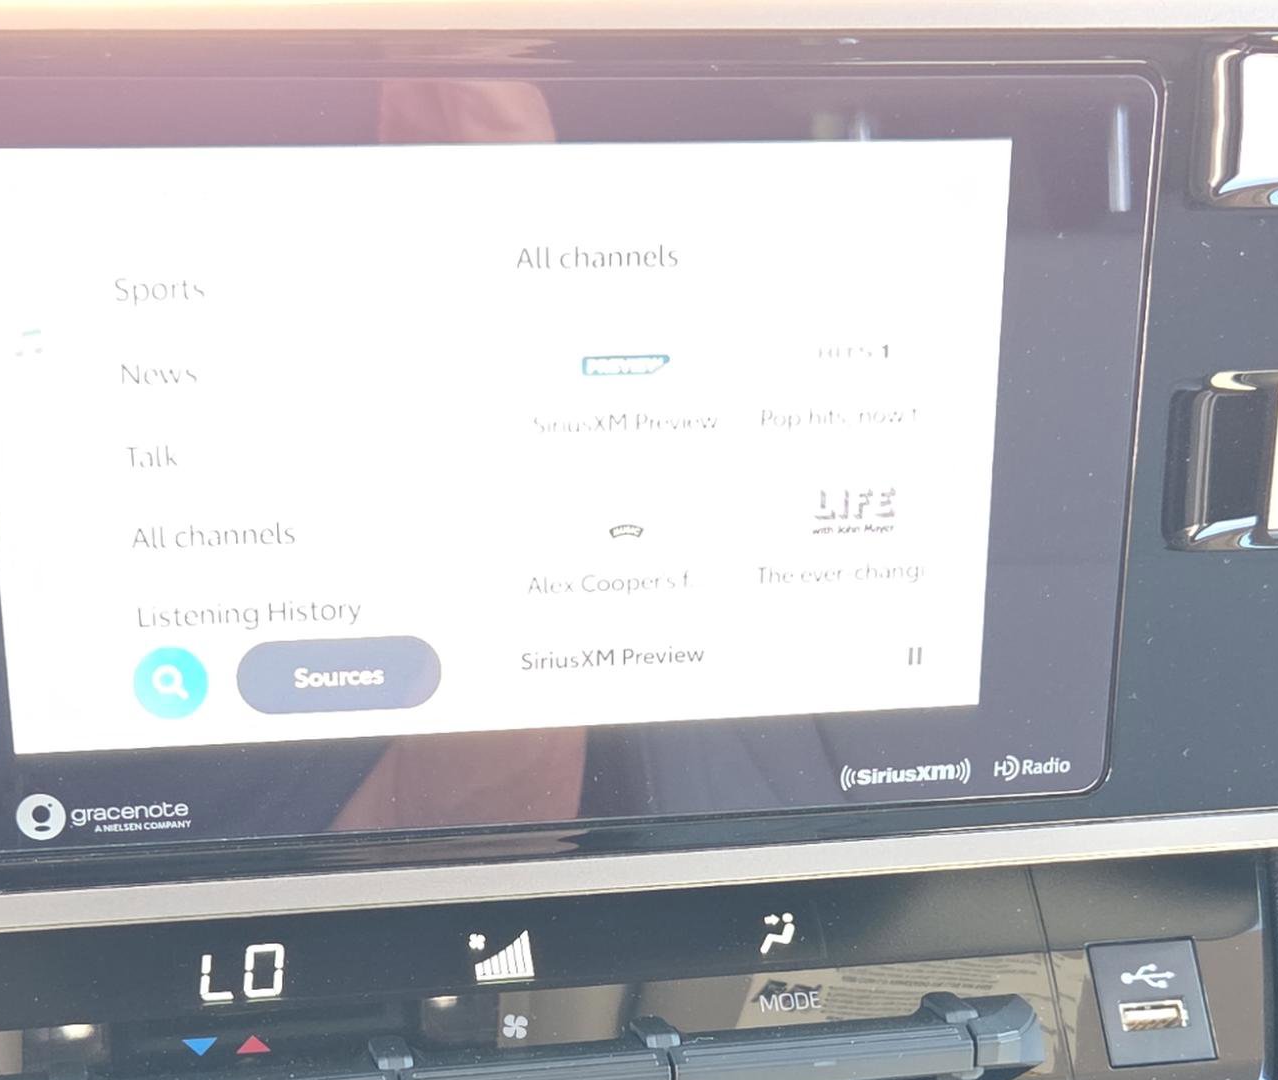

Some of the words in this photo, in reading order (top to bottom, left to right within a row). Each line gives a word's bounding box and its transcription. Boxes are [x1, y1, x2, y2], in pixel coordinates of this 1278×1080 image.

[517, 247, 551, 269] All
[560, 244, 679, 268] channels
[115, 278, 206, 306] Sports
[120, 364, 198, 386] News
[531, 413, 628, 434] SiriusXM
[635, 412, 719, 432] Preview
[761, 408, 801, 431] Pop
[859, 410, 905, 424] now
[126, 446, 179, 470] Talk
[814, 488, 896, 520] LIFE
[132, 525, 169, 549] All
[175, 522, 296, 547] channels
[527, 576, 574, 594] Alex
[757, 566, 794, 585] The
[138, 604, 259, 629] Listening
[268, 600, 362, 626] History
[521, 649, 615, 671] SiriusXM
[623, 646, 705, 667] Preview
[294, 666, 384, 689] Sources
[1022, 756, 1071, 775] Radio
[71, 802, 189, 826] gracenote
[94, 825, 102, 833] A
[104, 822, 142, 832] NIELSEN
[144, 820, 191, 831] COMPANY
[759, 991, 821, 1013] MODE
